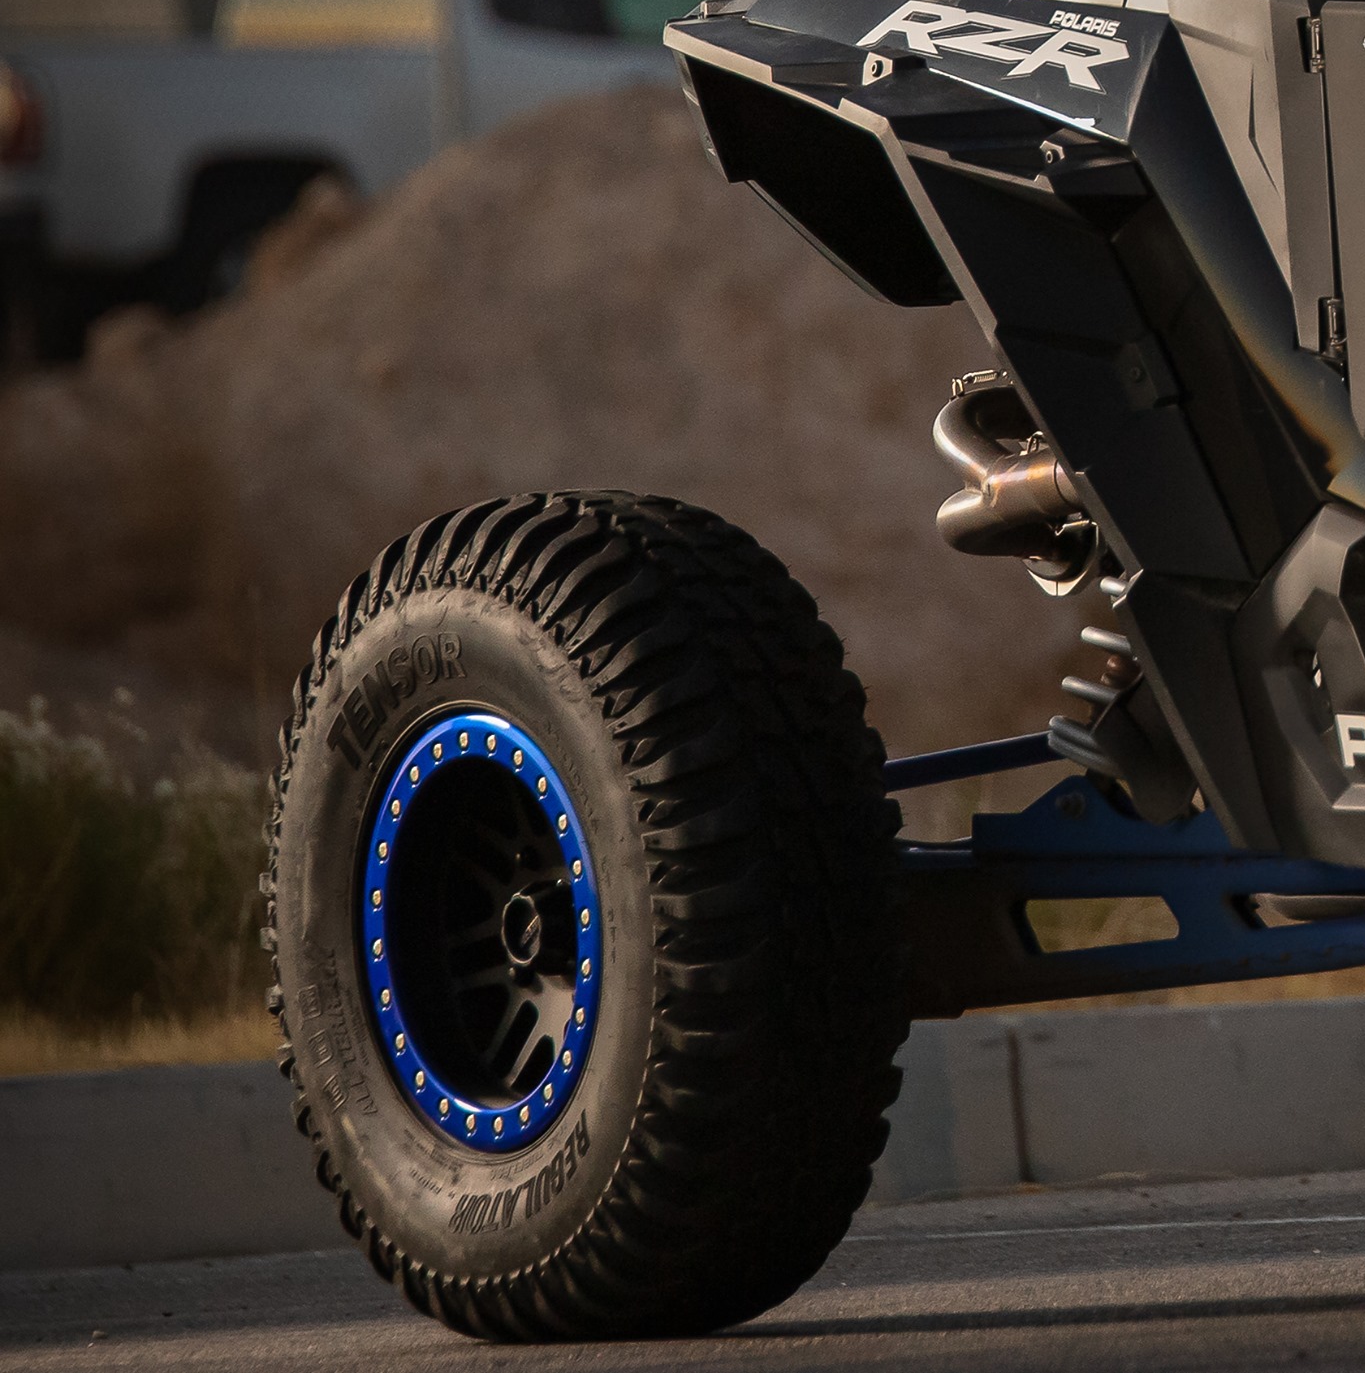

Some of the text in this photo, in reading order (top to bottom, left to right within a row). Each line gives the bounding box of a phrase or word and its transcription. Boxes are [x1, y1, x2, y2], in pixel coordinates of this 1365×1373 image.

[857, 0, 1130, 95] RZR
[1049, 10, 1120, 38] POLARIS
[326, 632, 466, 770] TENSOR
